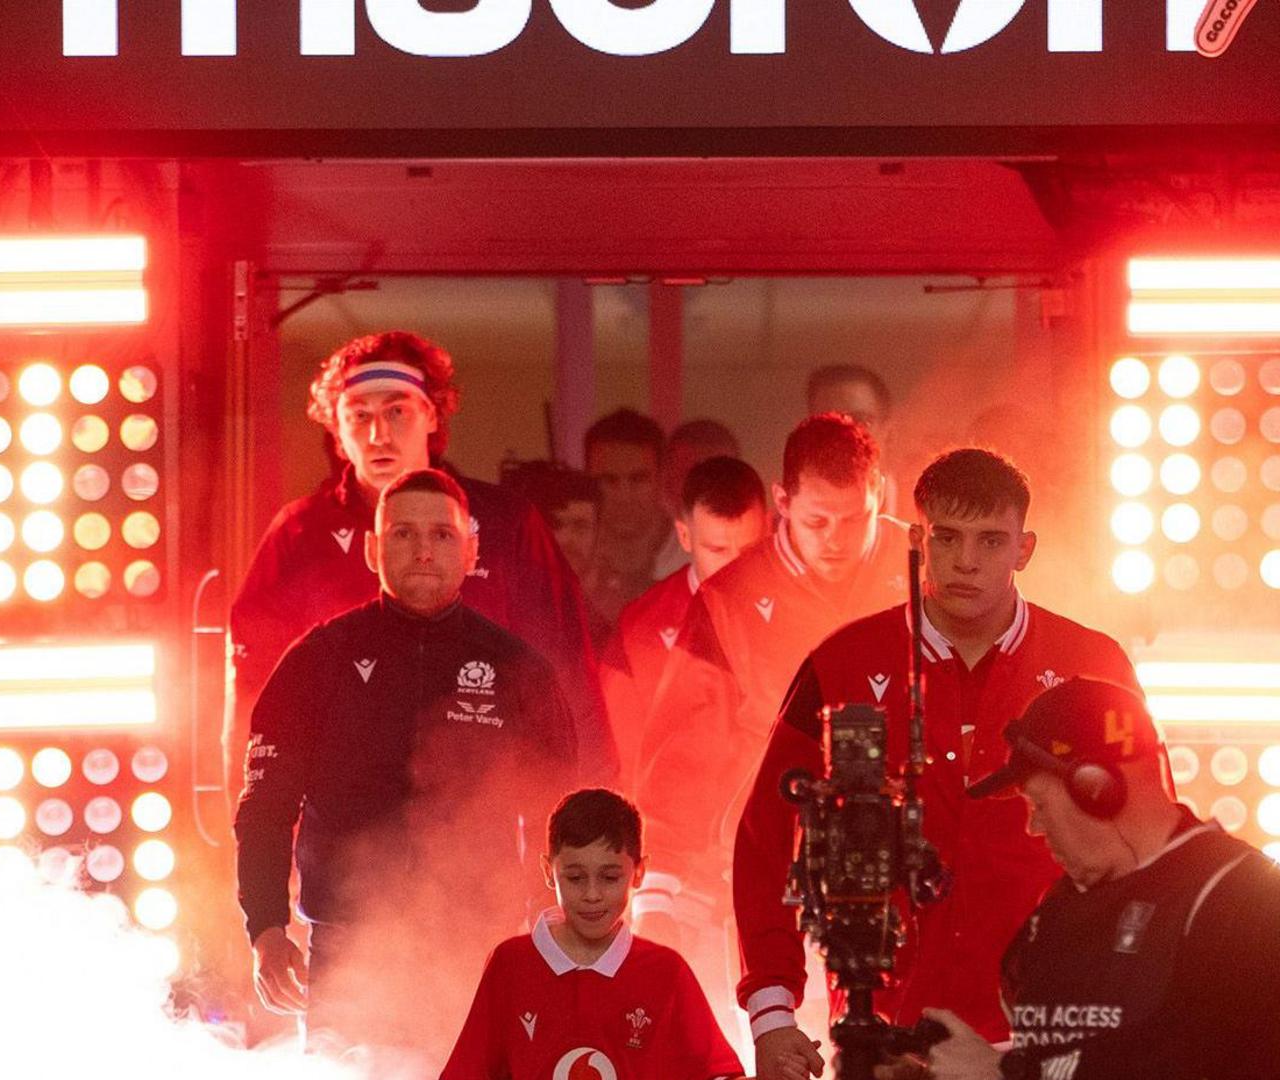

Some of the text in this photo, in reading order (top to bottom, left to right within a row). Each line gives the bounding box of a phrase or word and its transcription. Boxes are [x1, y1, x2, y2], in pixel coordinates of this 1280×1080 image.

[1205, 0, 1243, 42] GO.CO
[447, 710, 504, 728] Peter Vardy
[1104, 709, 1134, 757] 4
[1051, 1005, 1122, 1029] ACCESS
